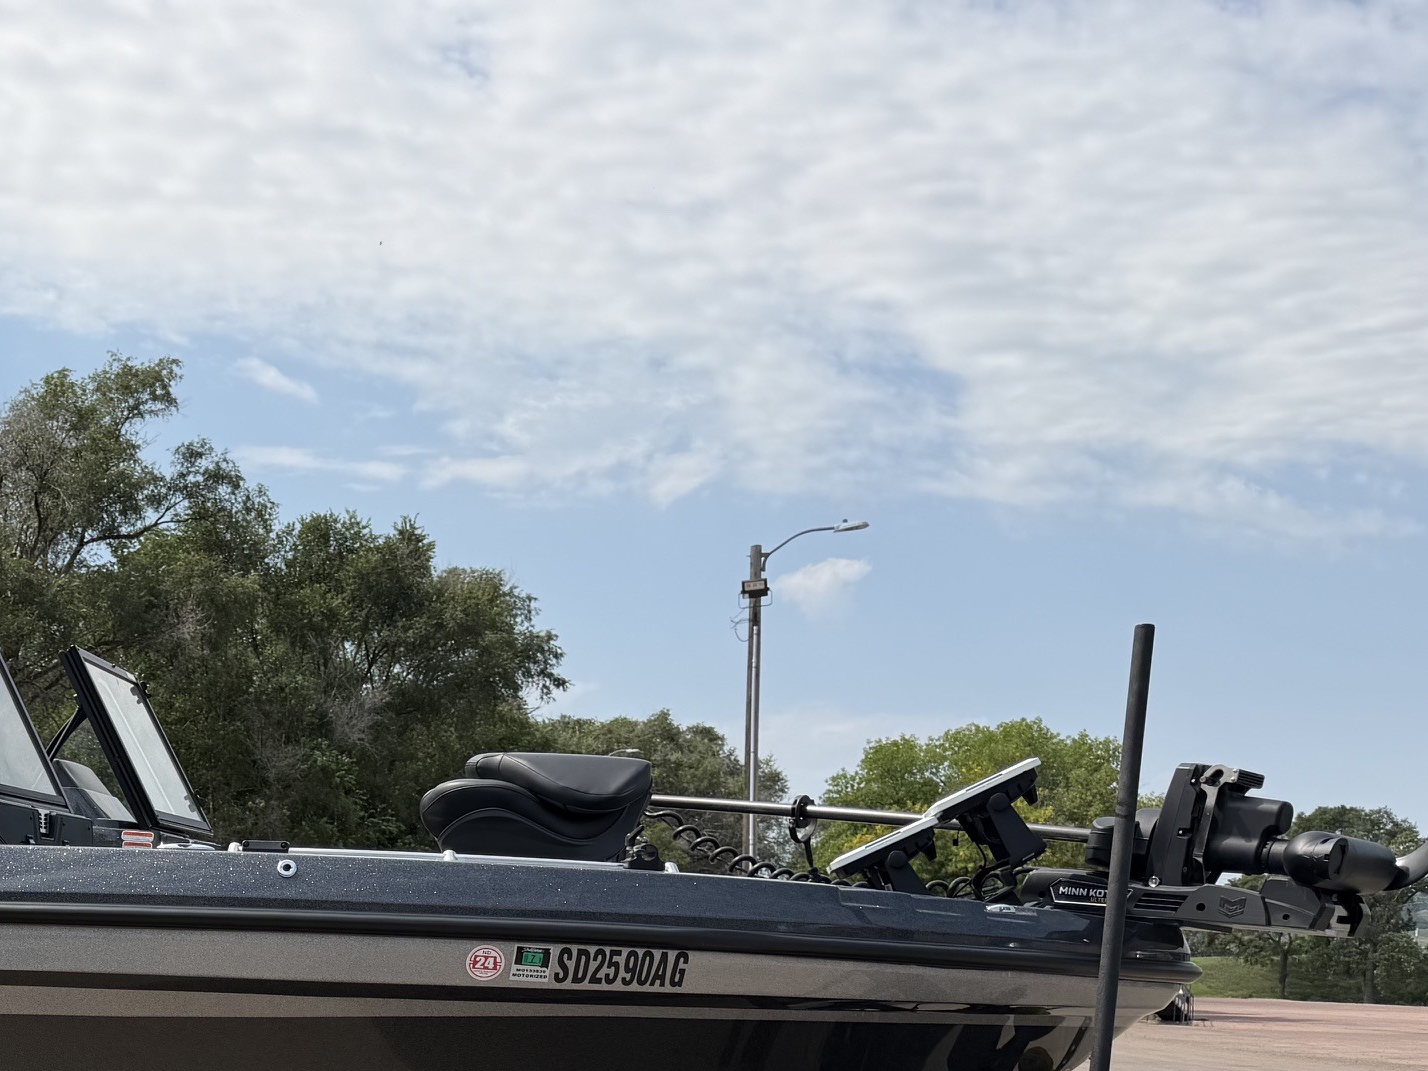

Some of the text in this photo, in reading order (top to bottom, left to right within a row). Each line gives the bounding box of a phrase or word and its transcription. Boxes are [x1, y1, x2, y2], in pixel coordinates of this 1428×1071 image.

[1059, 886, 1109, 898] MINN KOT
[474, 956, 495, 969] 24
[553, 946, 690, 988] SD2590AG
